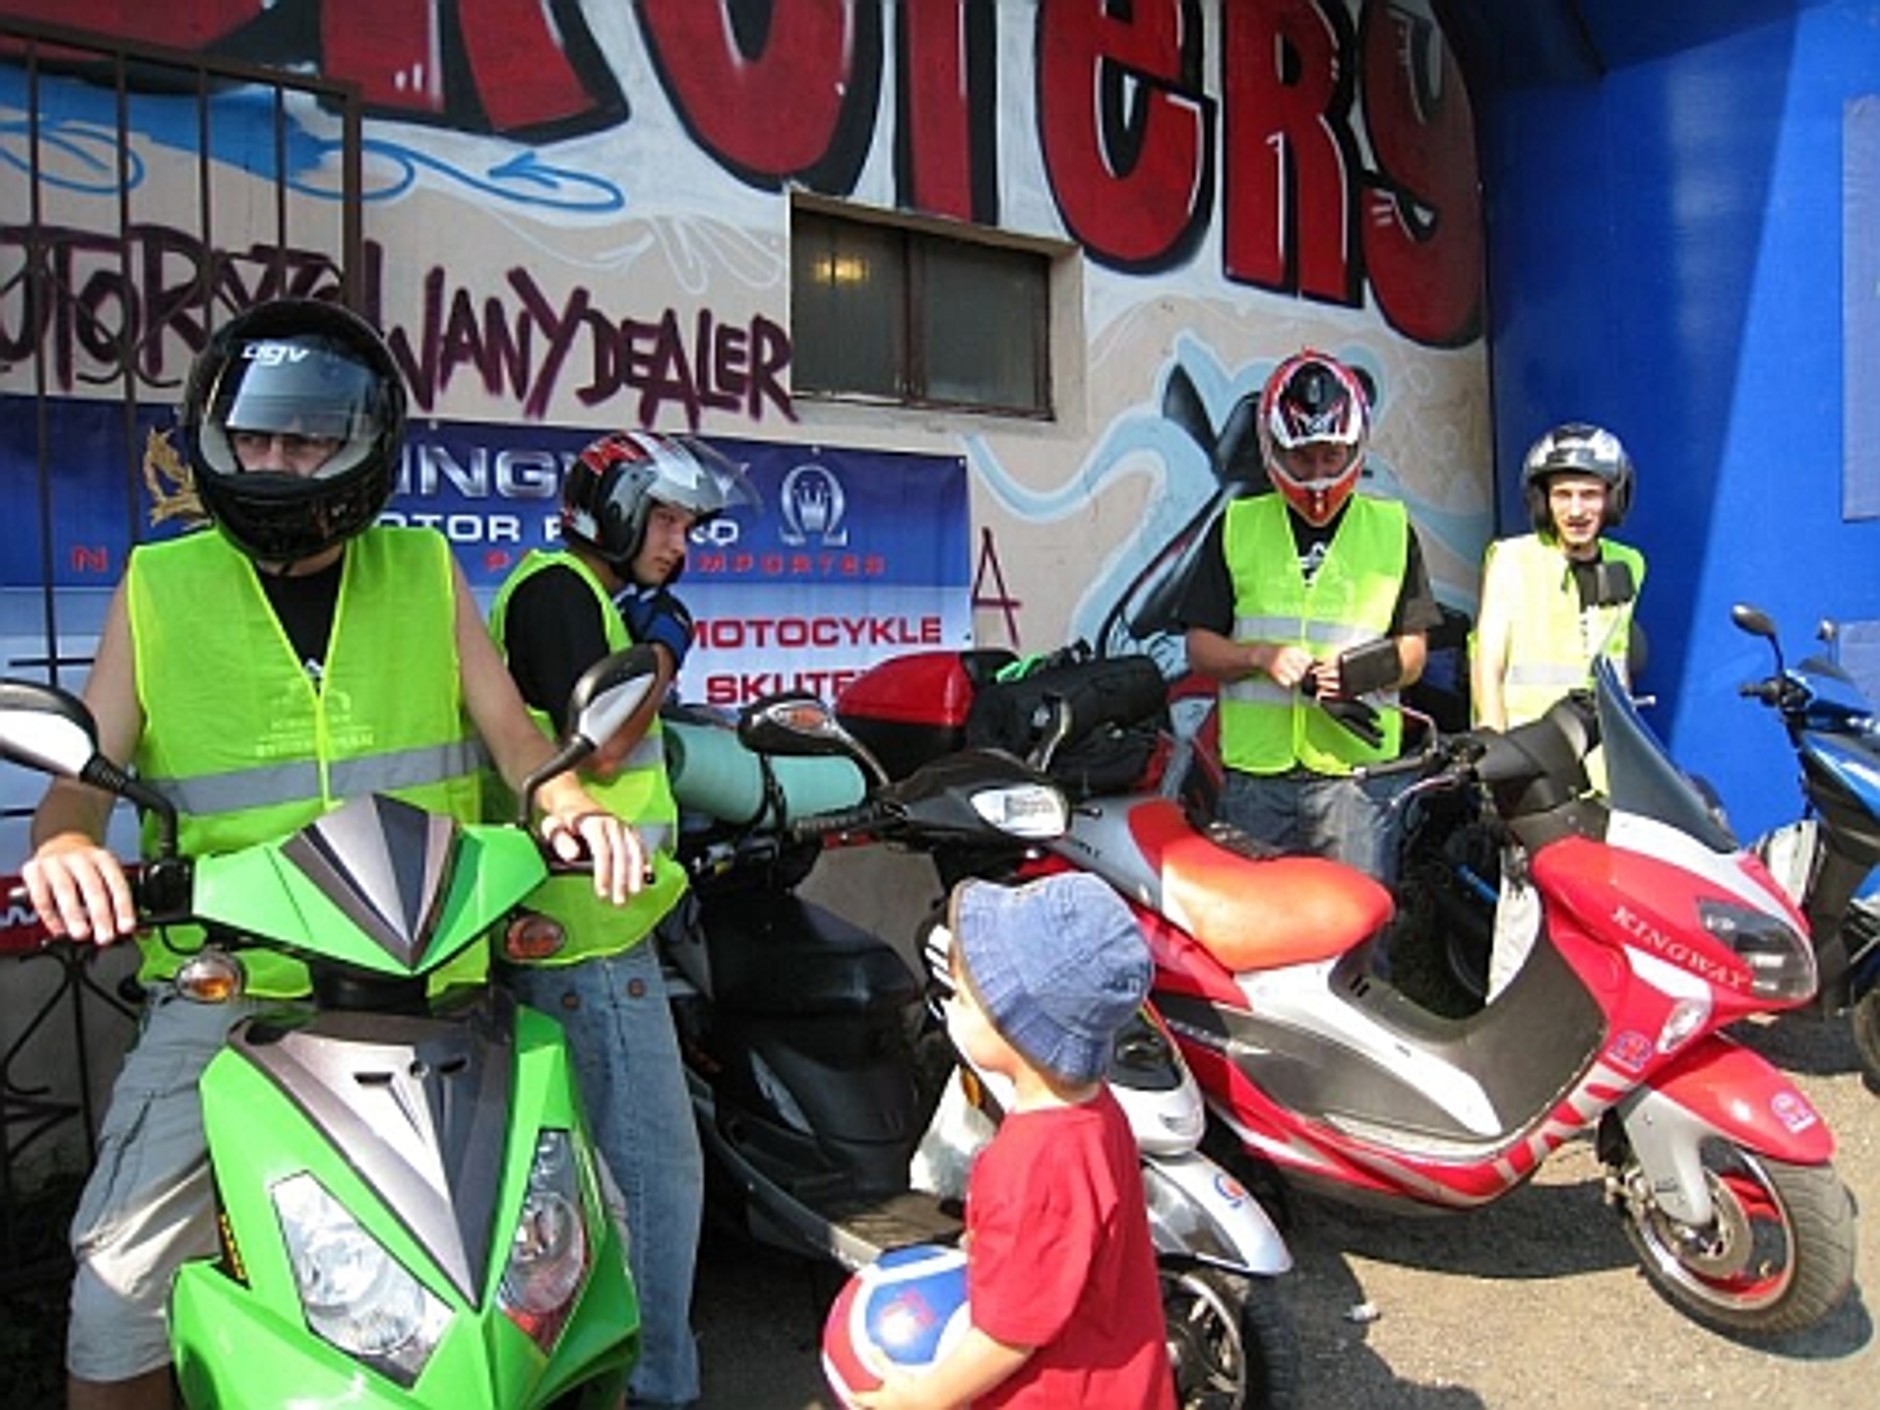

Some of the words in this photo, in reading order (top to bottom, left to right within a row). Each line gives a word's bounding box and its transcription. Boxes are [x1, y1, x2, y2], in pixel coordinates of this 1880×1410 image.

[575, 308, 799, 430] DEALER
[690, 614, 942, 650] MOTOCYKLE
[1610, 906, 1750, 989] KINGWAY
